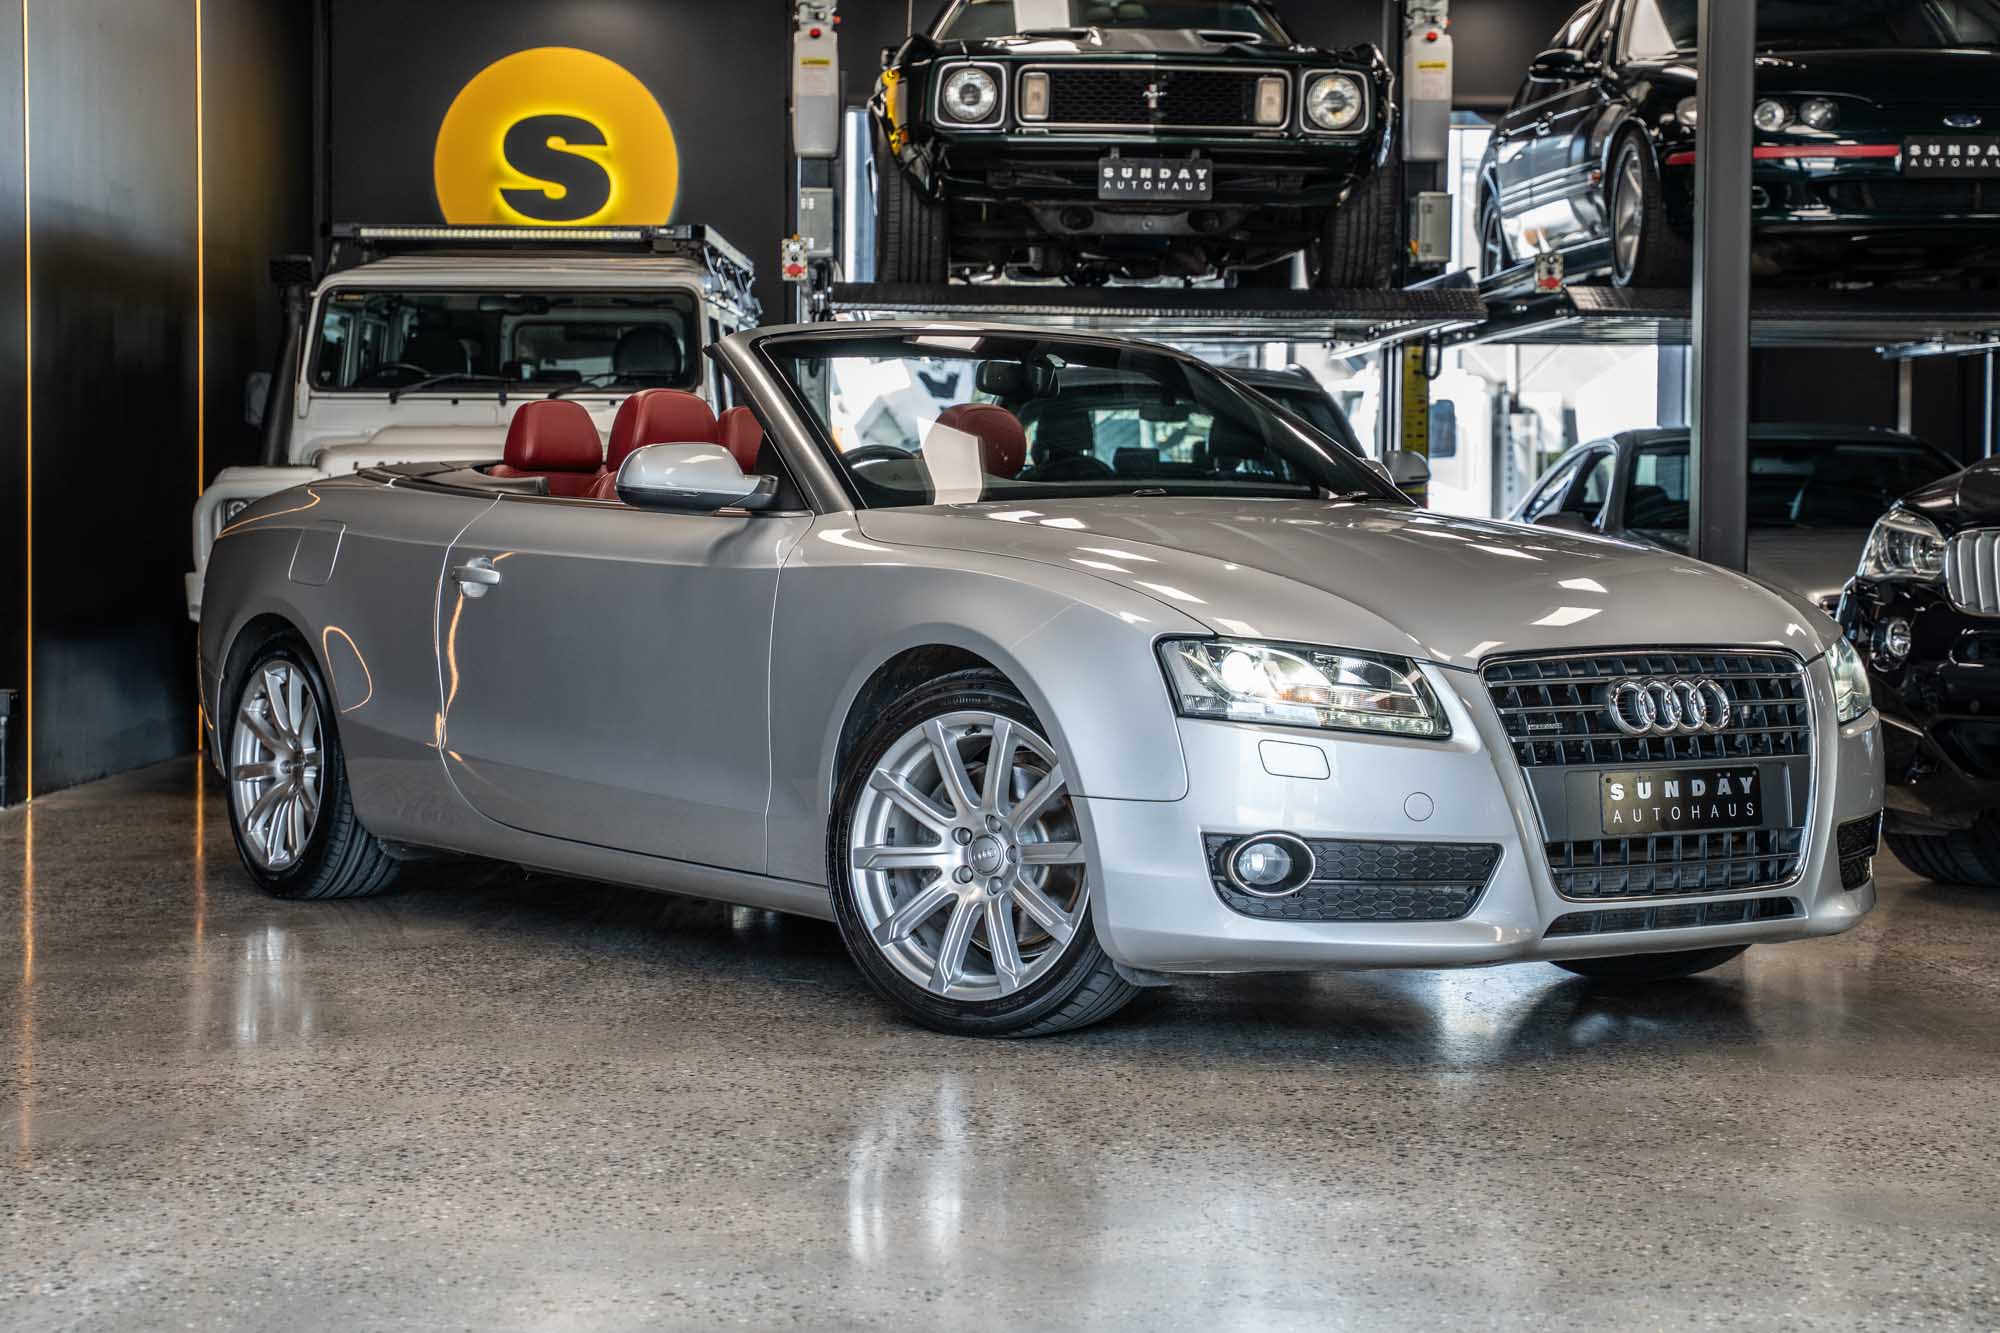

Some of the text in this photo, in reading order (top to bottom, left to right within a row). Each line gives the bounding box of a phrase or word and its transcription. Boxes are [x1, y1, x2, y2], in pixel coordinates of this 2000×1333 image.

[1909, 144, 2000, 156] SUNDA
[499, 114, 611, 222] S
[1103, 167, 1208, 179] SUNDAY
[1103, 180, 1207, 191] AUTOHAUS
[1610, 776, 1754, 801] SUNDAY
[1613, 802, 1755, 824] AUTOHAUS
